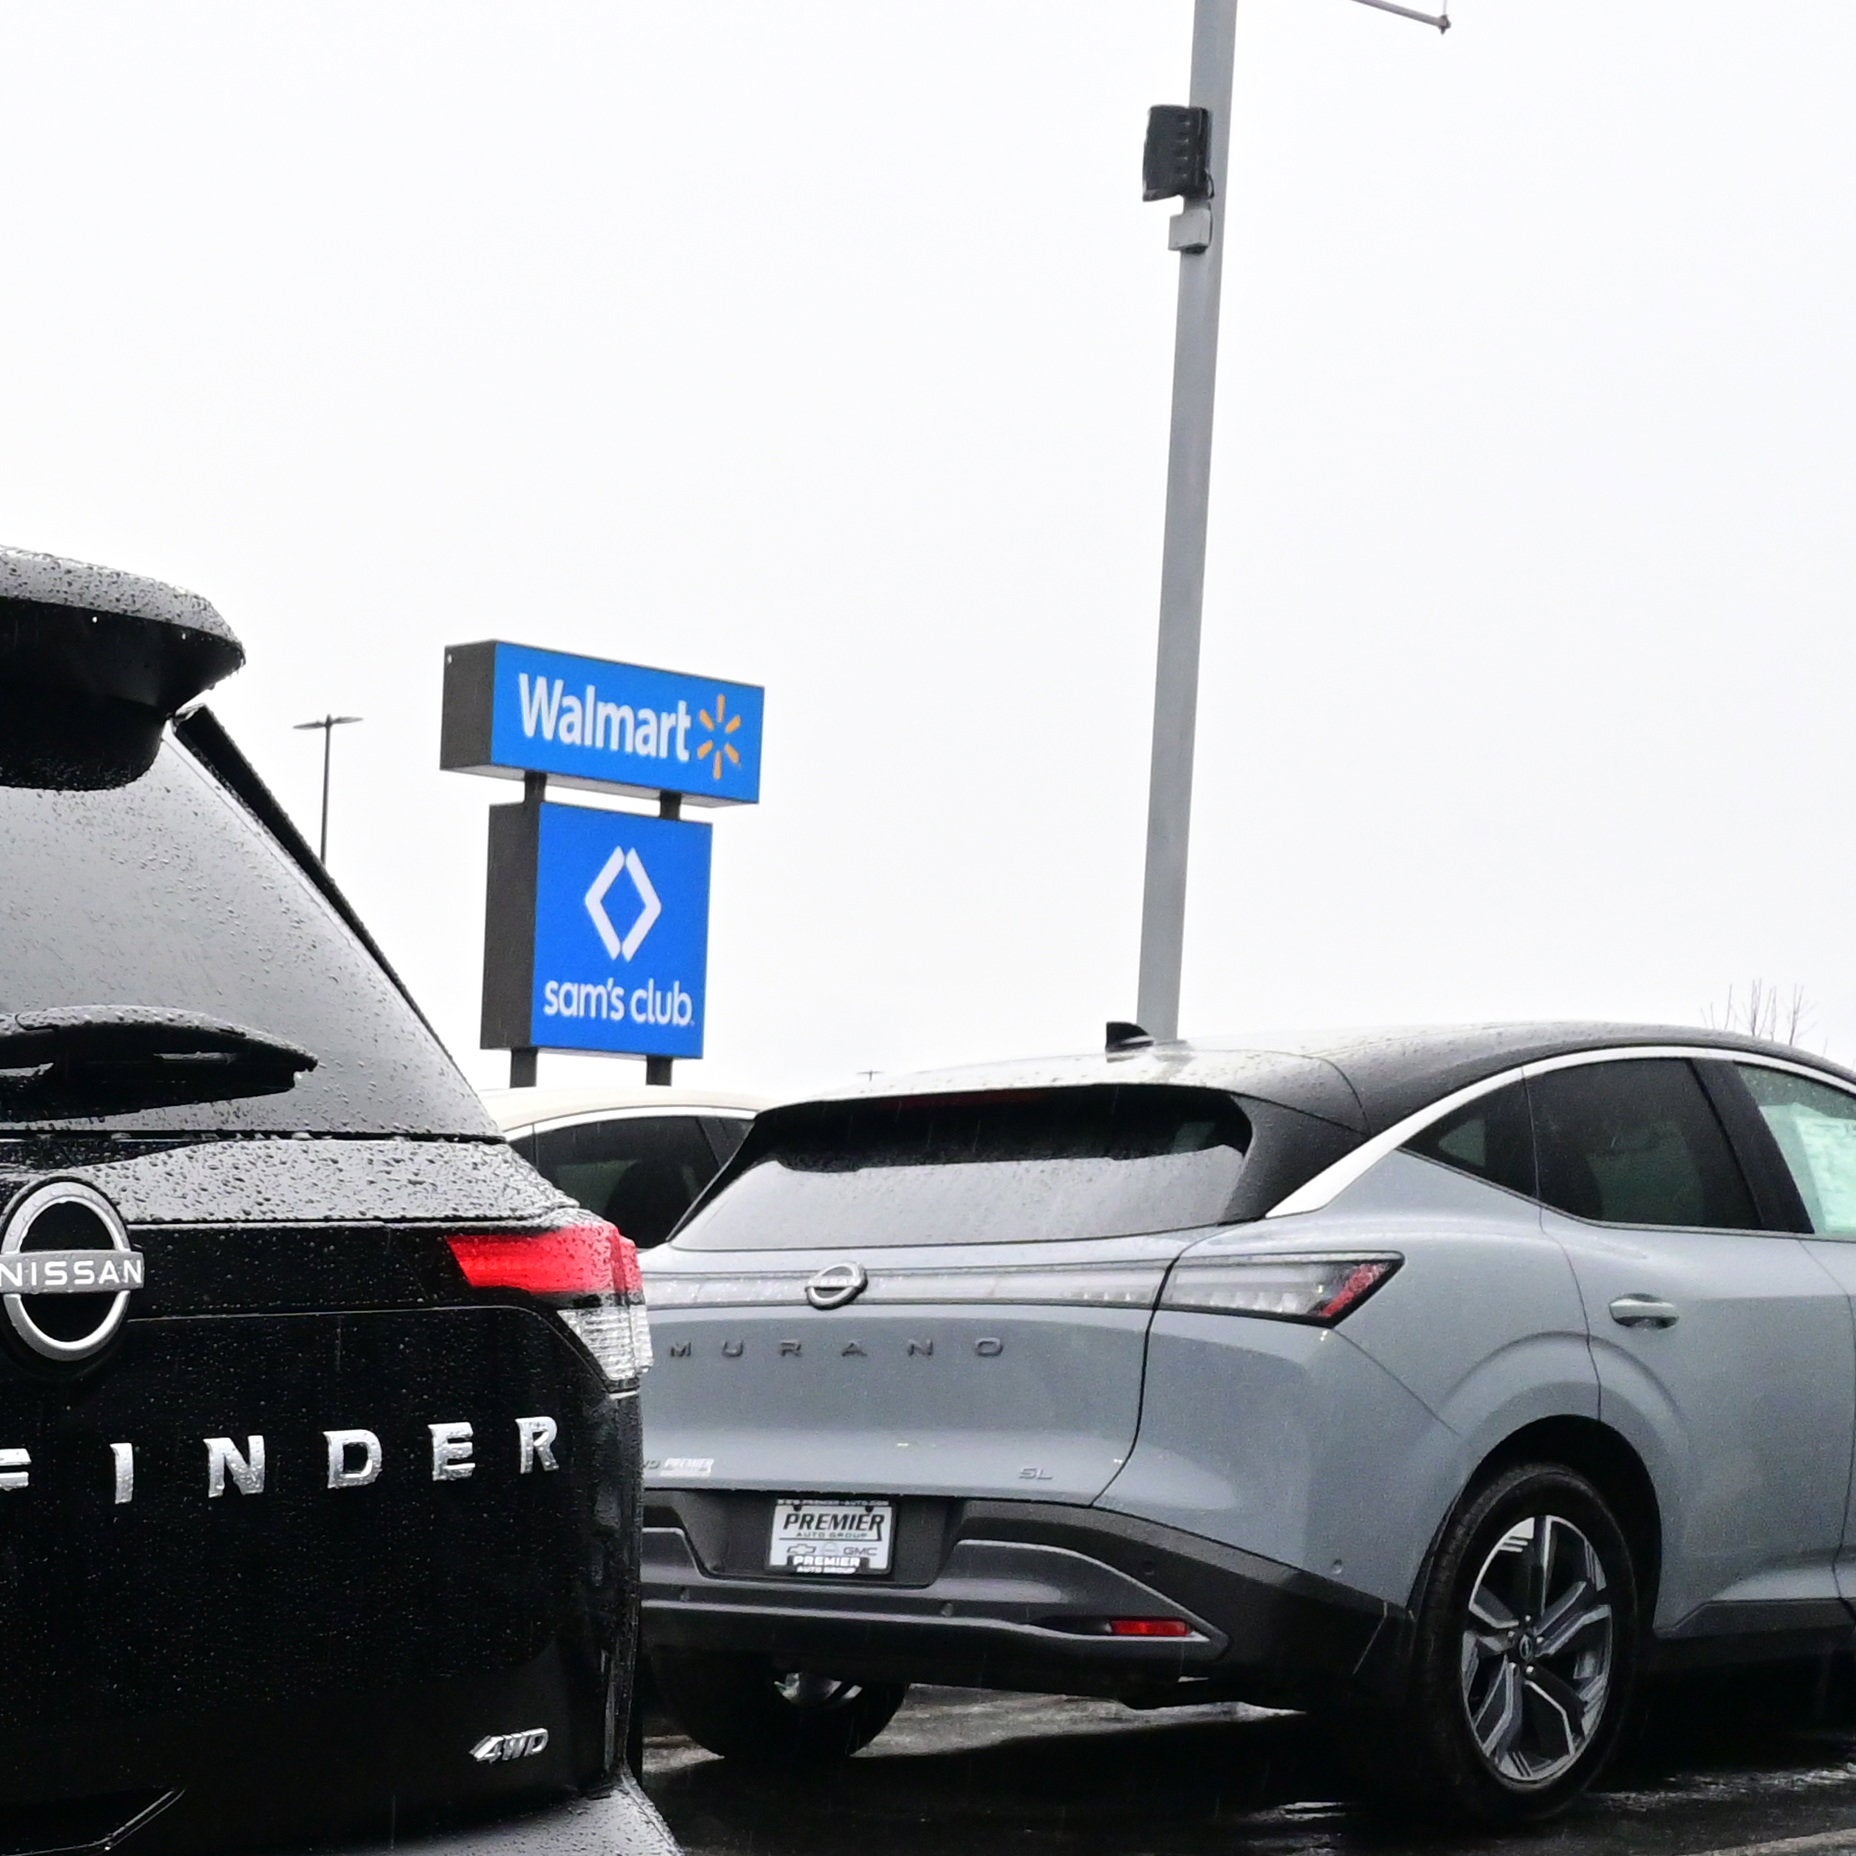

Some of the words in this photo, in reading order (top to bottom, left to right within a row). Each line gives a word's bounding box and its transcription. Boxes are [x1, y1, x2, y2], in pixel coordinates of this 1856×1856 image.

[518, 673, 691, 762] Walmart
[543, 977, 625, 1021] sam's
[630, 977, 693, 1026] club
[668, 1336, 1004, 1358] MURANO
[1019, 1466, 1053, 1480] SL
[783, 1513, 885, 1534] PREMIER
[793, 1555, 860, 1567] PREMIER
[843, 1547, 878, 1556] GMC
[469, 1728, 549, 1763] 4WD
